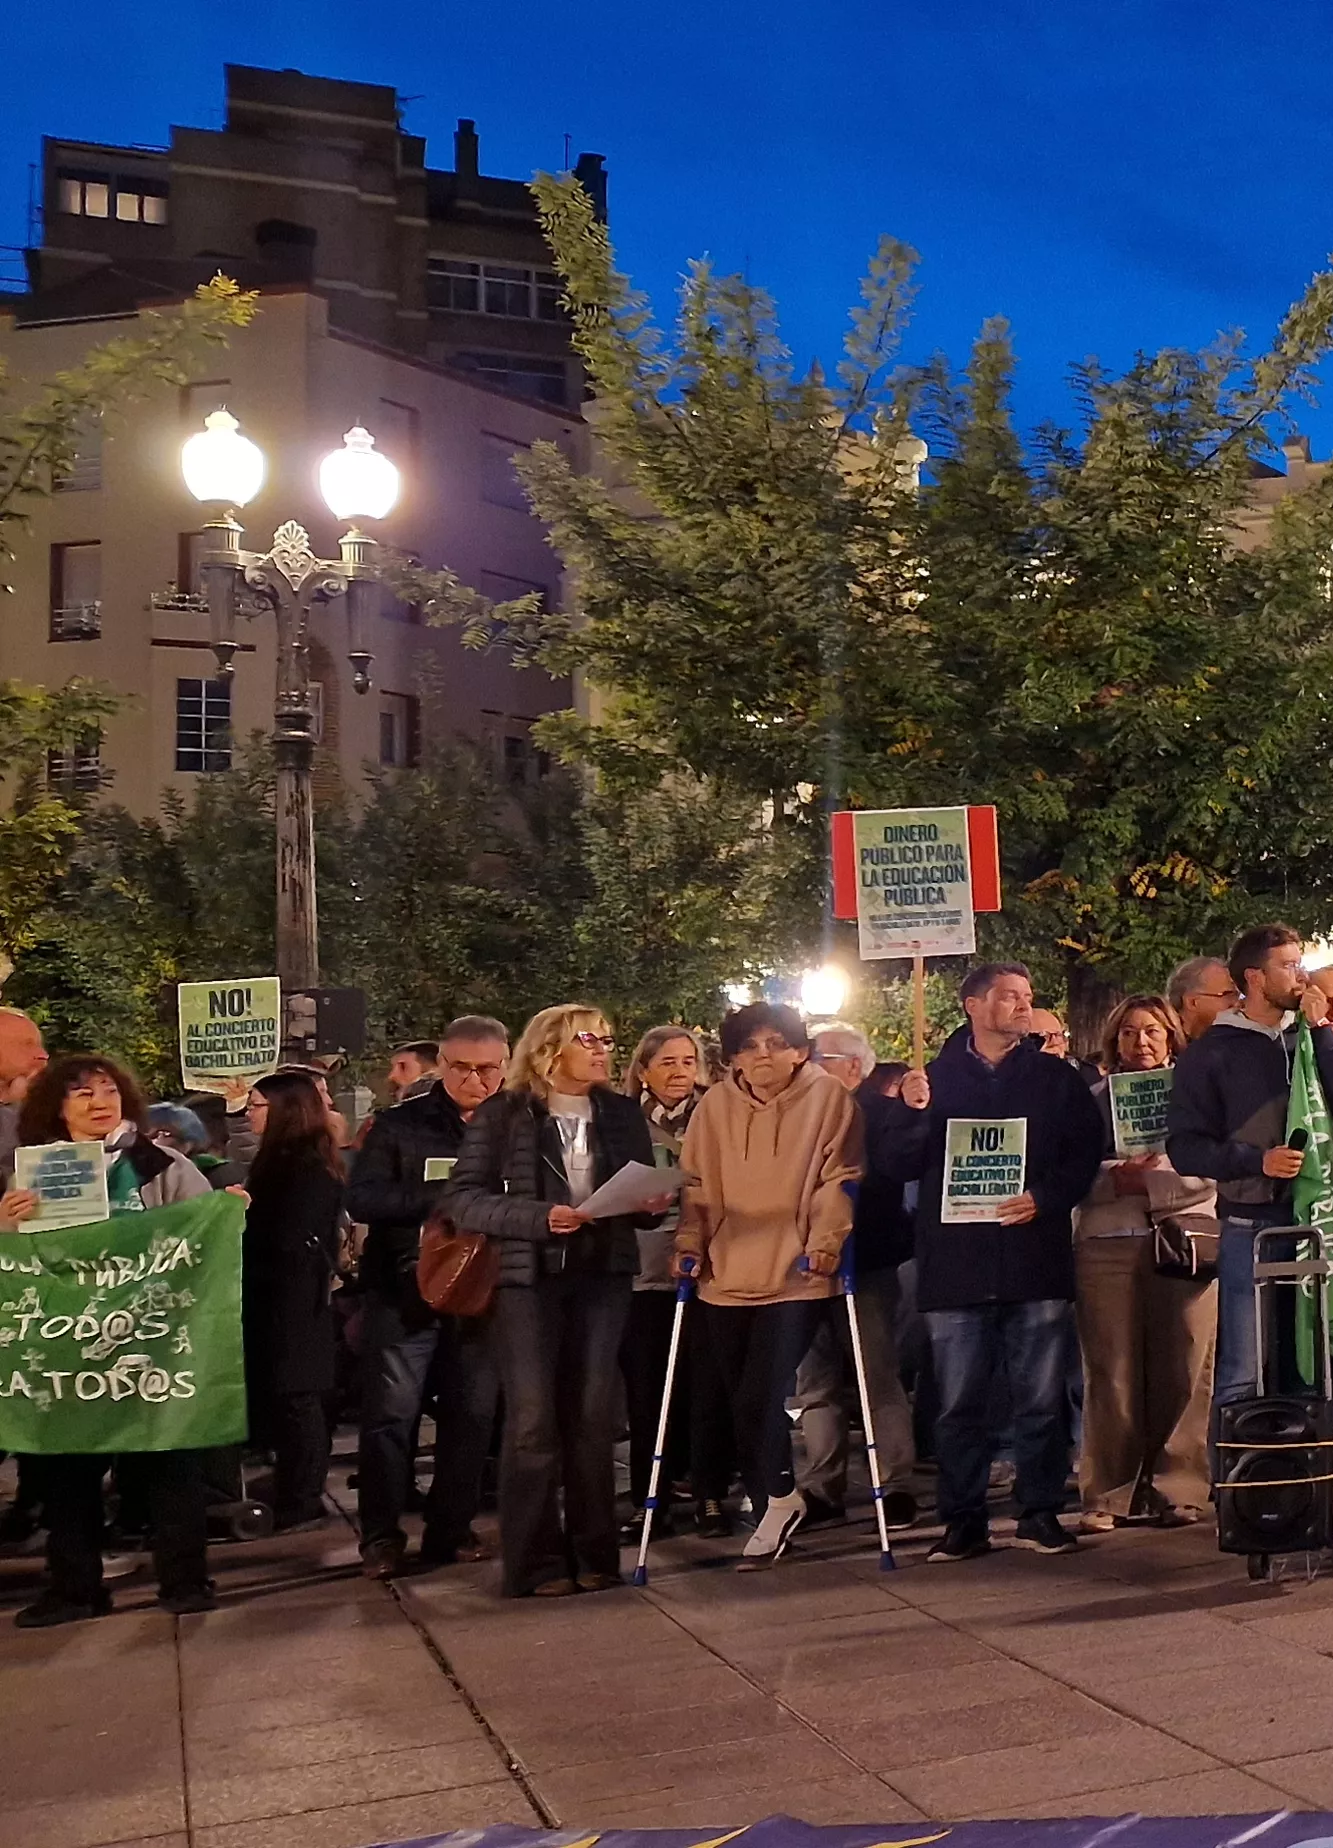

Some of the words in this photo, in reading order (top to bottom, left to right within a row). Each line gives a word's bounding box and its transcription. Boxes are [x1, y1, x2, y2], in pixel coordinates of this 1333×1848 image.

[884, 823, 938, 843] DINERO
[925, 844, 964, 863] PARA
[862, 869, 880, 887] LA
[208, 988, 252, 1018] NO!
[187, 1024, 202, 1037] AL
[205, 1017, 275, 1037] CONCIERTO
[187, 1036, 257, 1053] EDUCATIVO
[260, 1034, 275, 1048] EN
[971, 1127, 1005, 1151] NO!
[13, 1310, 171, 1345] TOD@S
[41, 1368, 196, 1403] TOD@S
